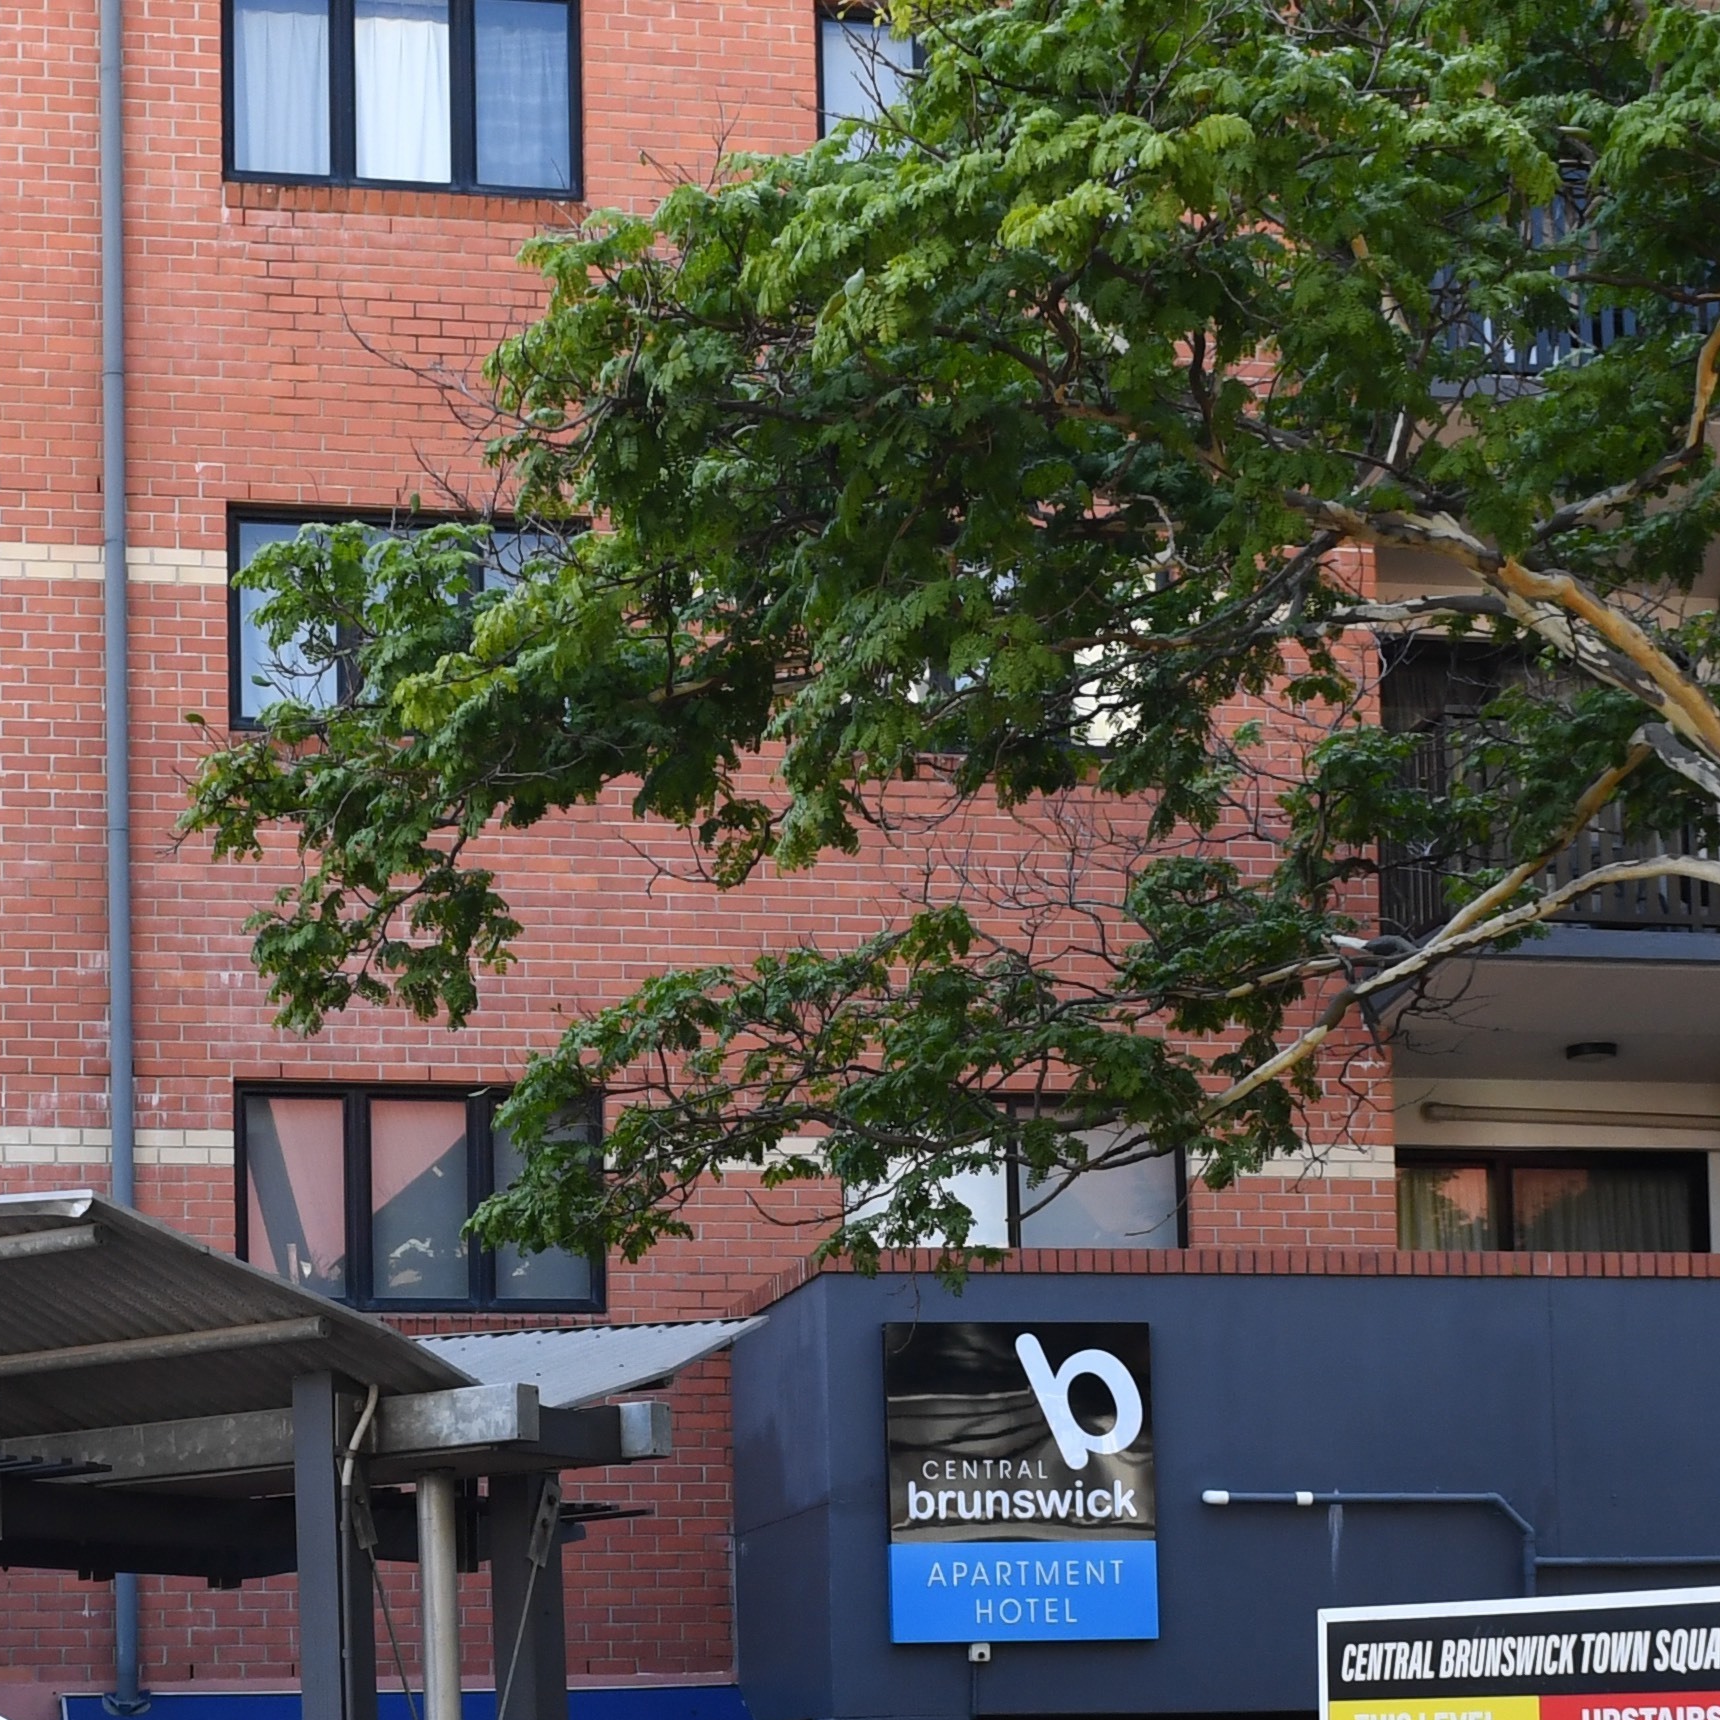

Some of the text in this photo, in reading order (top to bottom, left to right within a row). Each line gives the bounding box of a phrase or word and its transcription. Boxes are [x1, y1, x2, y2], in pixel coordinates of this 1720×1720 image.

[922, 1459, 1049, 1480] CENTRAL
[908, 1479, 1138, 1520] brunswick
[927, 1560, 1125, 1587] APARTMENT
[975, 1598, 1079, 1624] HOTEL
[1341, 1641, 1435, 1682] CENTRAL
[1438, 1633, 1578, 1679] BRUNSWICK
[1581, 1630, 1652, 1674] TOWN
